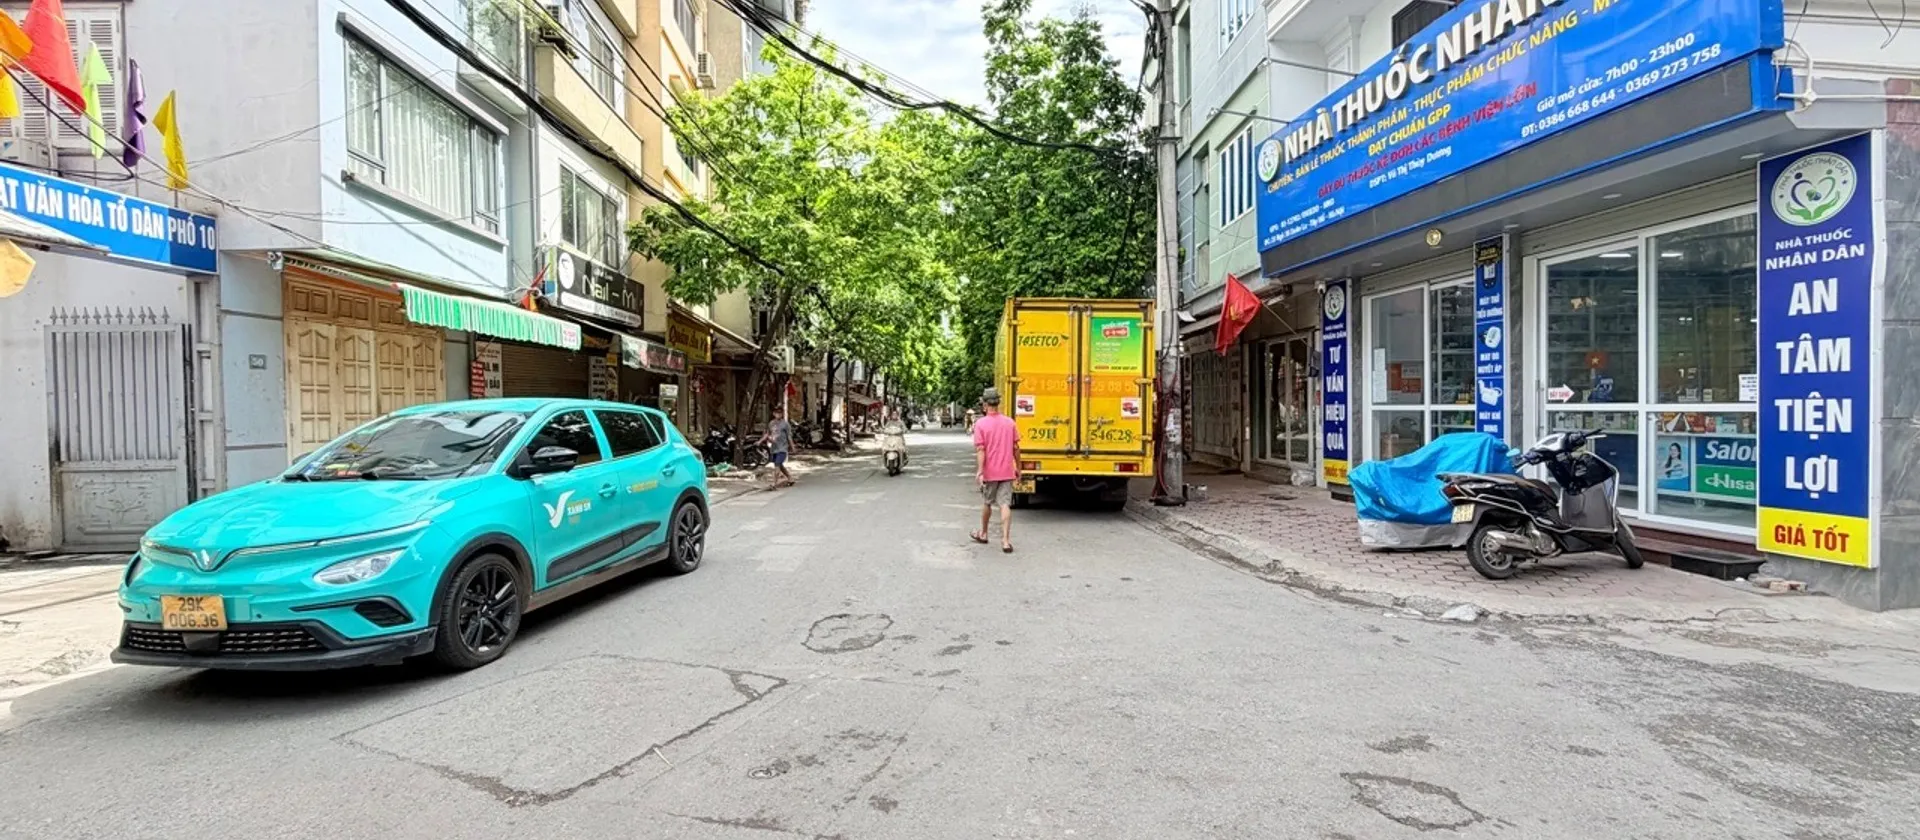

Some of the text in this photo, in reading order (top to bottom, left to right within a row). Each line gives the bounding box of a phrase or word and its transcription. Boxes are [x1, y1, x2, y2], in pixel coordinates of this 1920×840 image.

[1487, 38, 1527, 72] CHỨC
[1529, 9, 1578, 49] NĂNG
[1536, 95, 1555, 114] Giờ
[1558, 84, 1576, 106] mở
[1577, 75, 1603, 96] cửa:
[1604, 57, 1639, 84] 7h00
[1648, 32, 1695, 64] 23h00
[1285, 107, 1333, 164] NHÀ
[1333, 40, 1430, 132] THUỐC
[1521, 122, 1538, 138] ĐT:
[1538, 110, 1567, 132] 0386
[1566, 98, 1590, 119] 668
[1591, 88, 1616, 110] 644
[1625, 68, 1659, 95] 0369
[1661, 56, 1689, 80] 273
[1691, 43, 1722, 66] 758
[1427, 103, 1451, 125] GPP
[23, 179, 64, 219] VĂN
[68, 187, 105, 228] HÓA
[107, 194, 128, 233] TỔ
[132, 205, 165, 241] DÂN
[167, 213, 196, 247] PHỐ
[199, 224, 216, 251] 10
[1775, 227, 1853, 251] NHÀ THUỐC
[1765, 243, 1865, 271] NHÂN DÂN
[1788, 277, 1838, 317] AN
[1329, 344, 1341, 365] TƯ
[1775, 333, 1851, 375] TÂM
[1325, 369, 1344, 393] VẤN
[1325, 400, 1345, 425] HIỆU
[1774, 391, 1852, 440] TIỆN
[1090, 427, 1133, 442] 546.28
[1326, 427, 1345, 451] QUẢ
[1785, 454, 1839, 499] LỢI
[1774, 522, 1849, 553] GIÁ TỐT
[177, 596, 205, 613] 29K
[169, 612, 219, 628] 006.36
